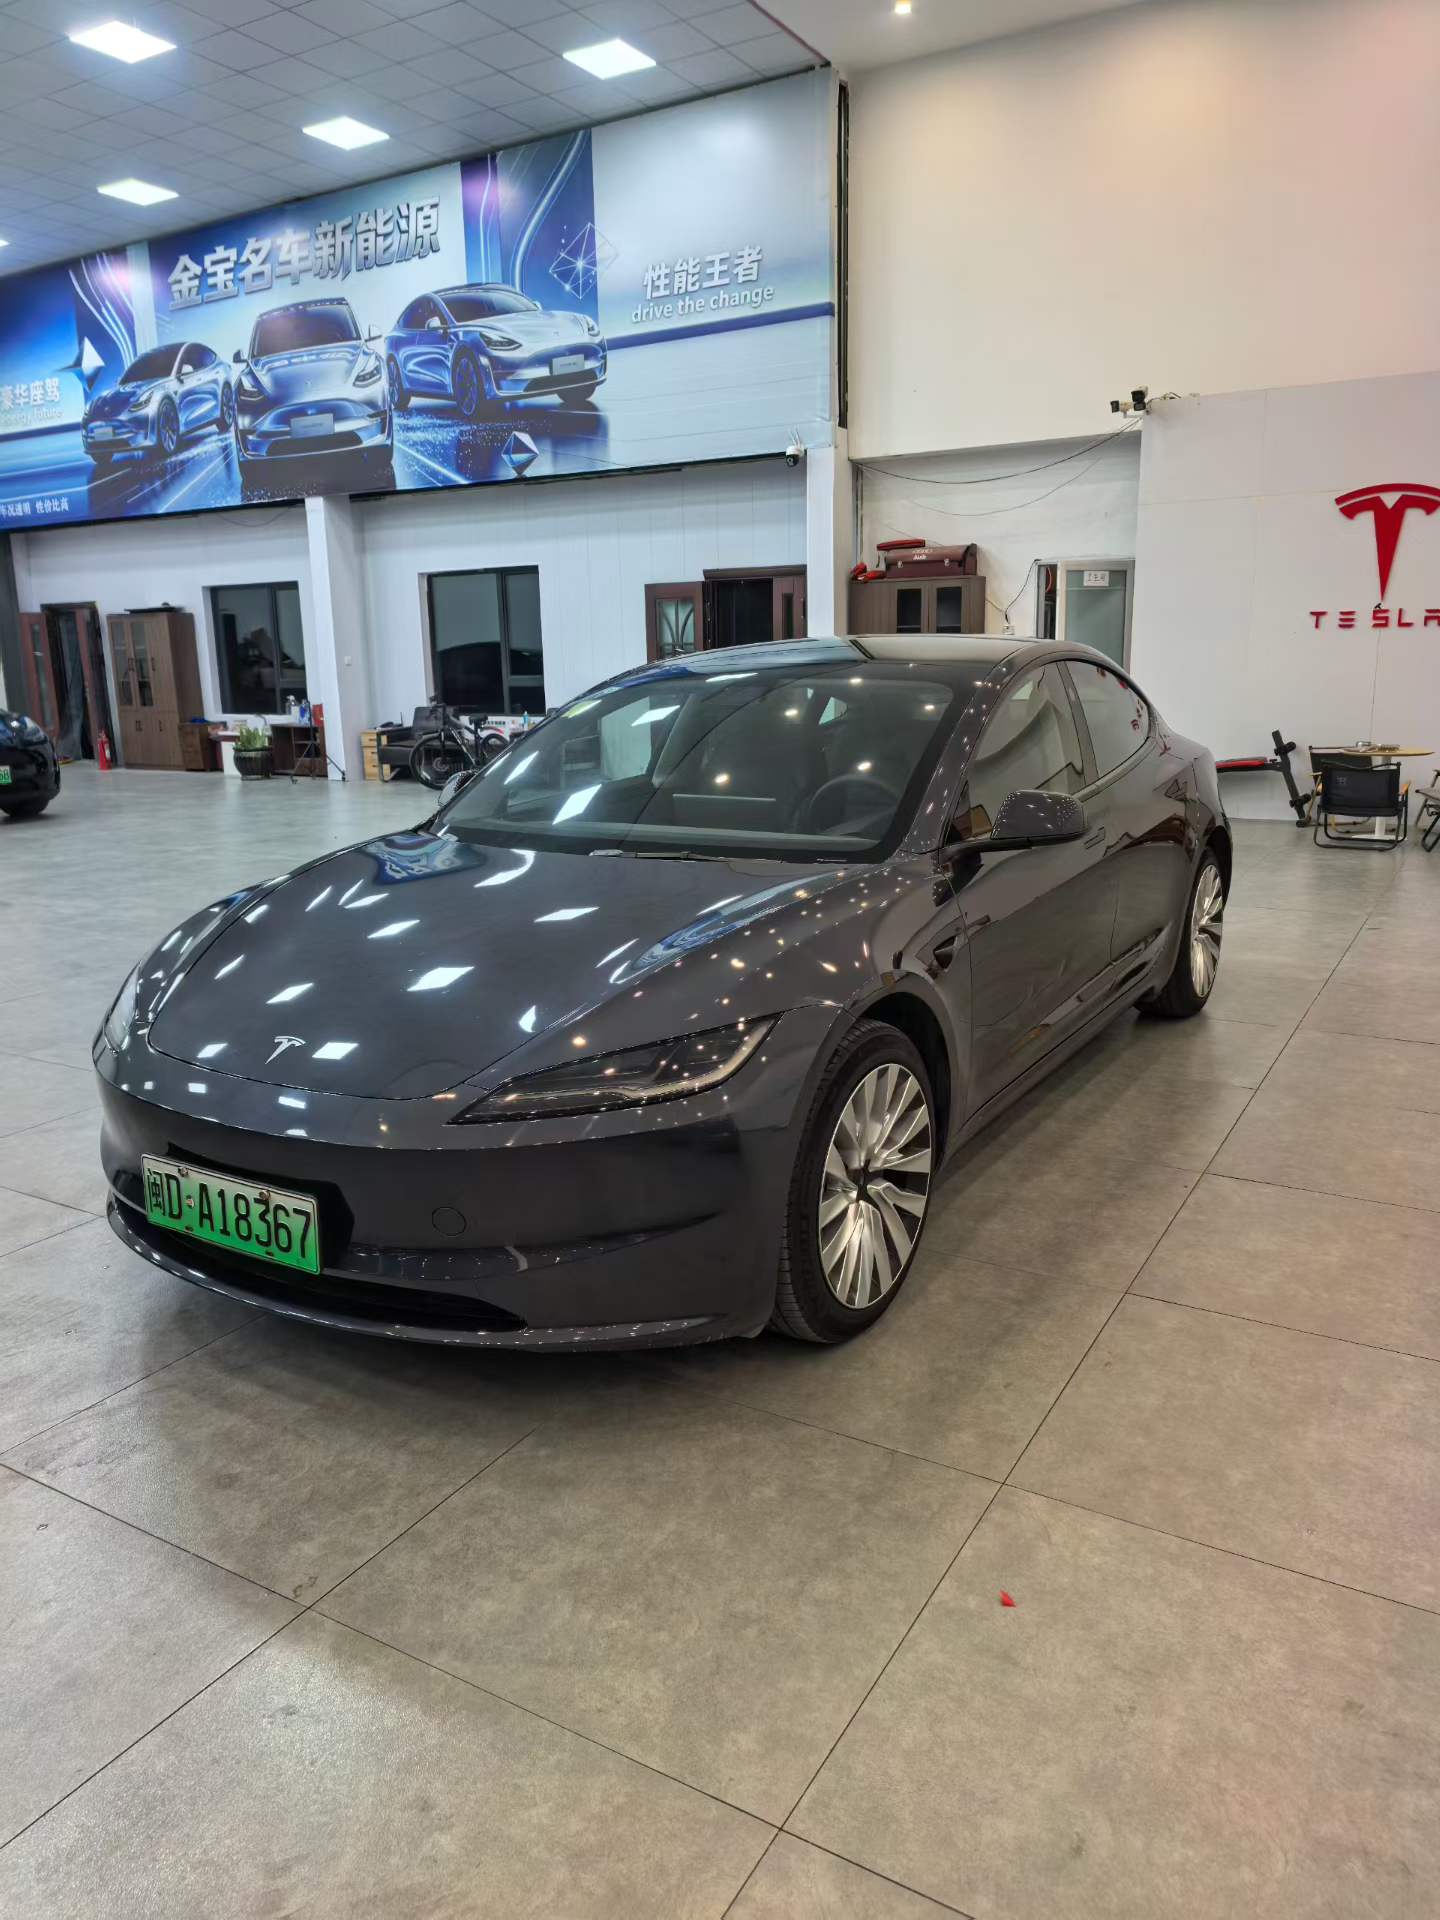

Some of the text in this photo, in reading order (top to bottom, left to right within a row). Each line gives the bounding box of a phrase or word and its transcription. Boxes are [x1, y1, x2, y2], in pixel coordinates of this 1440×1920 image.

[168, 196, 441, 310] 金宝名车新能源
[643, 246, 763, 300] 性能王者
[631, 286, 774, 323] drive the change
[1309, 607, 1440, 629] TESLA
